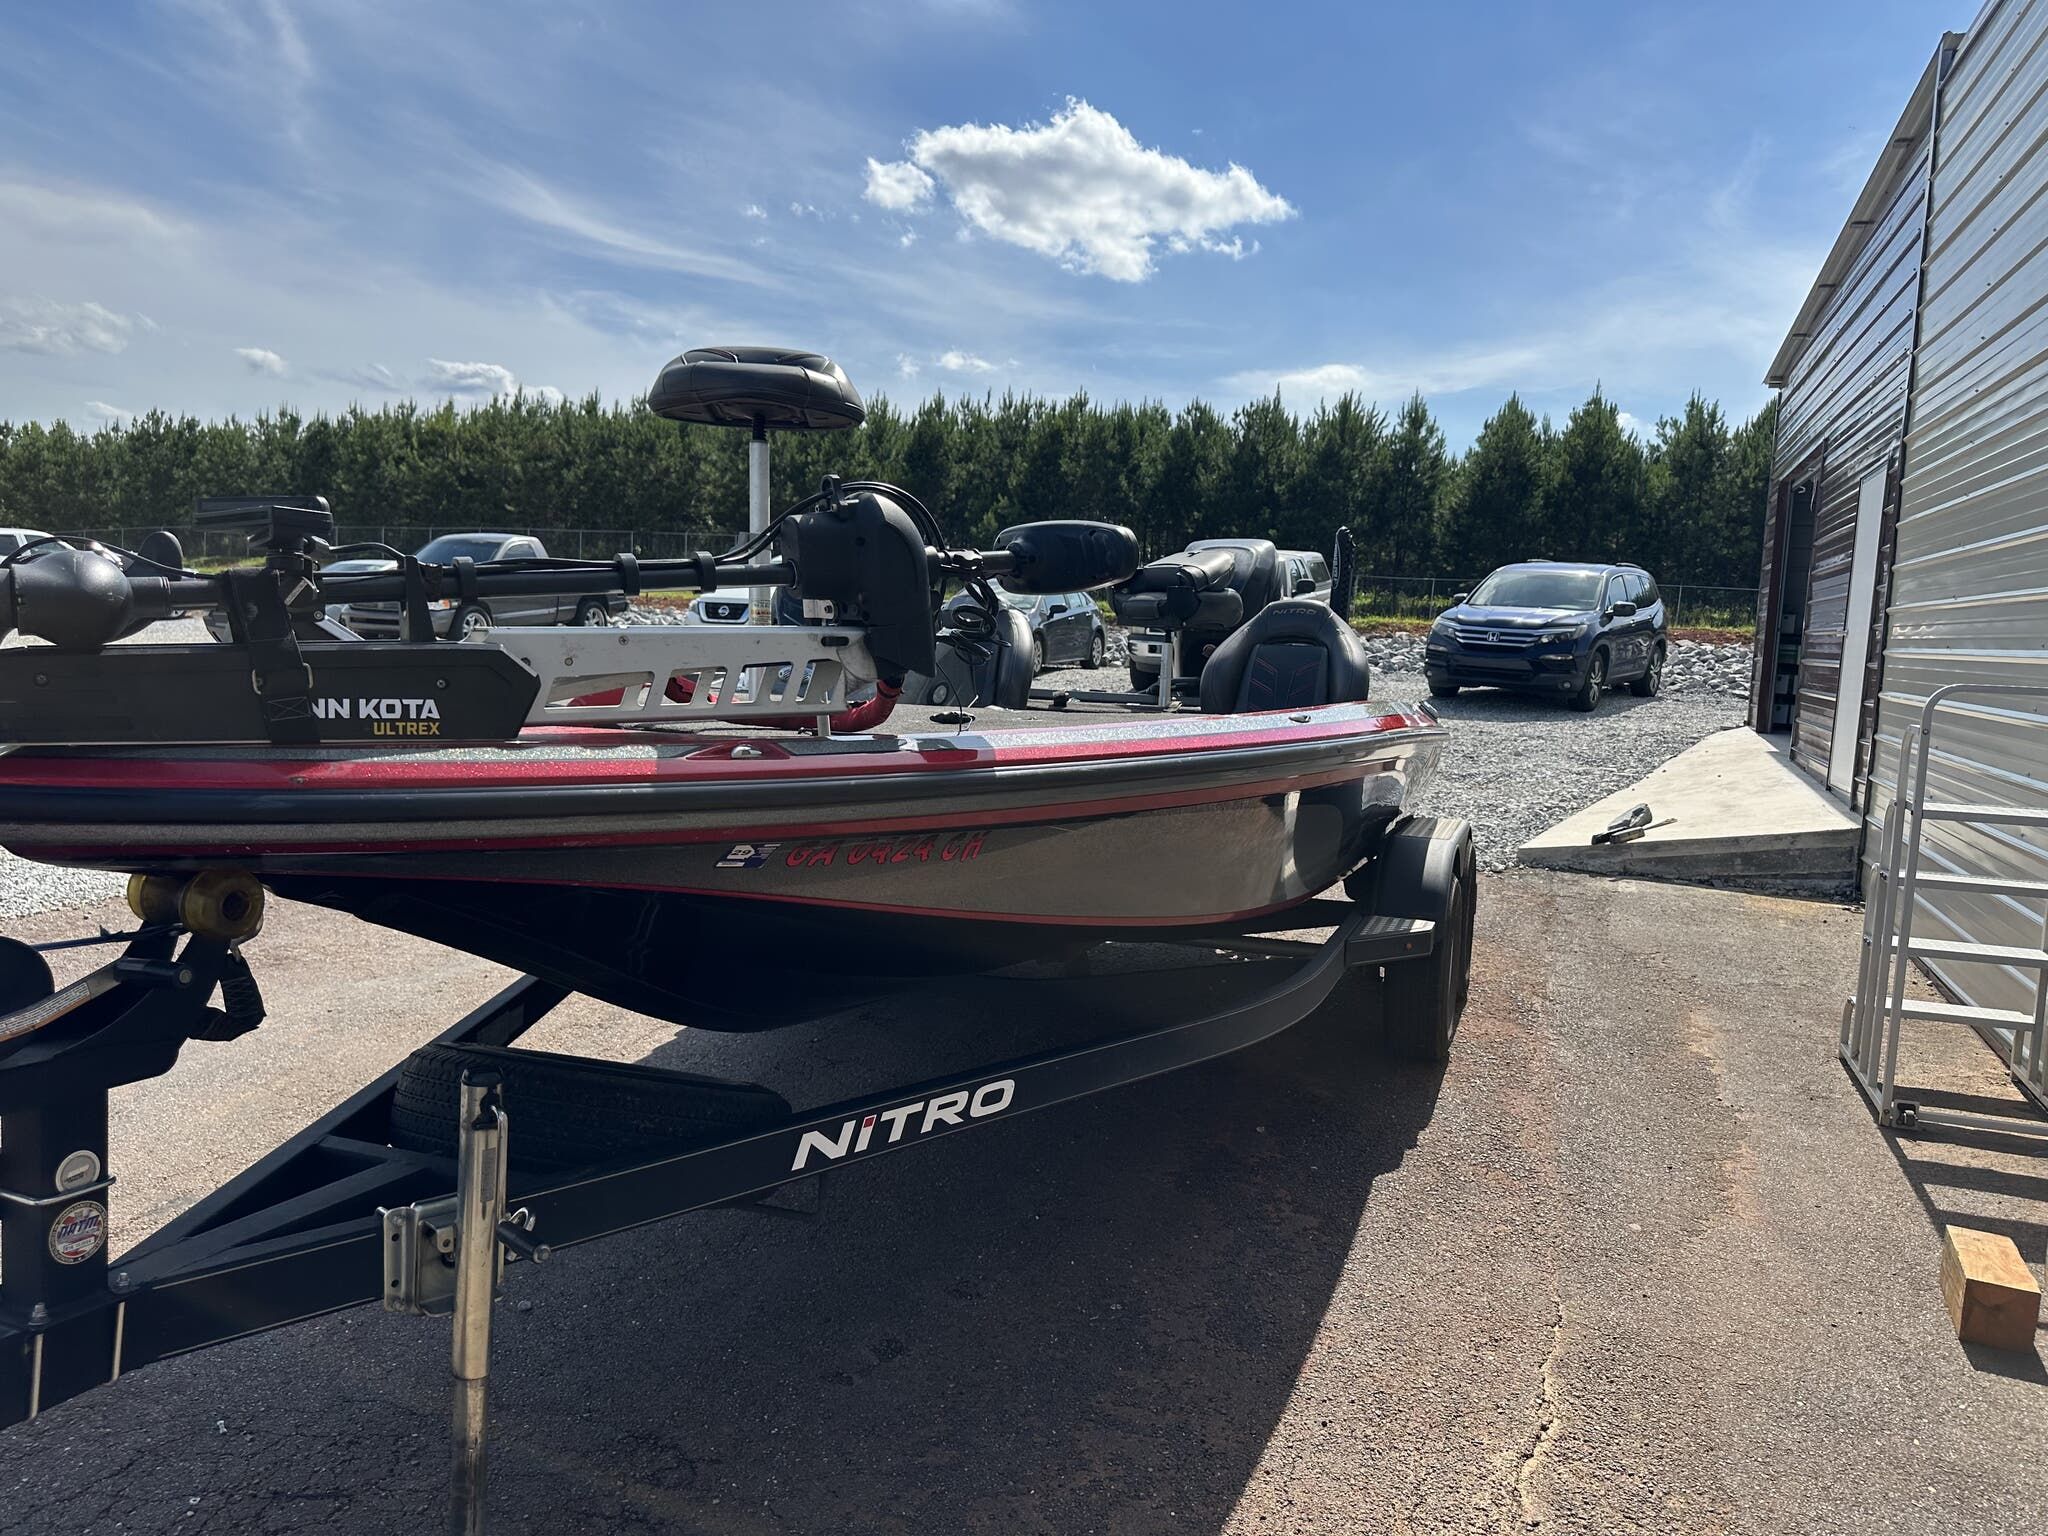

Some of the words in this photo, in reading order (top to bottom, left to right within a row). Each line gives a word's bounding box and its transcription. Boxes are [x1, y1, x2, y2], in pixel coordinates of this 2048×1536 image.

[311, 698, 350, 719] NN
[358, 698, 441, 719] KOTA
[373, 721, 440, 735] ULTREX
[786, 840, 845, 867] GA
